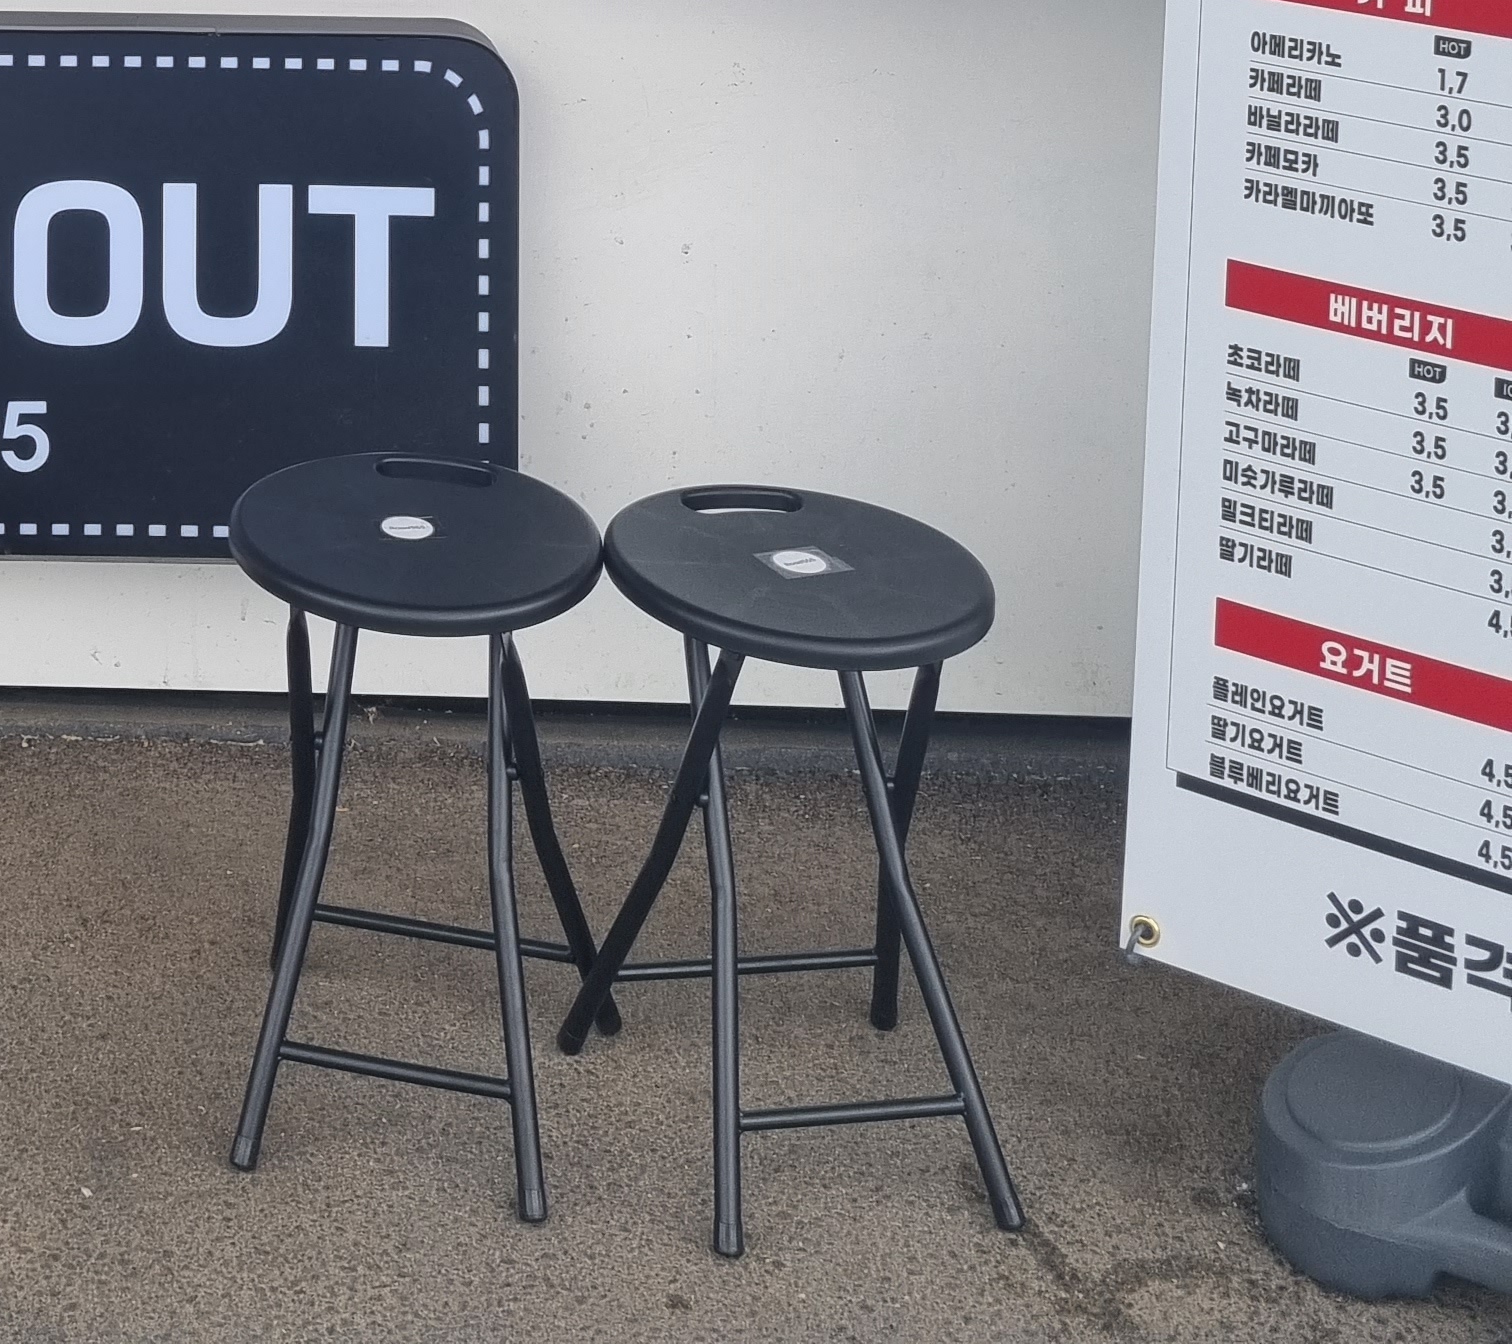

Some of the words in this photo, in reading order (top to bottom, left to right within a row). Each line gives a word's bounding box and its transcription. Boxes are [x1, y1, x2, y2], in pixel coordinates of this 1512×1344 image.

[1250, 31, 1342, 68] 아메리카노
[1437, 68, 1468, 95] 1,7
[1439, 40, 1467, 55] HOT
[1249, 68, 1322, 102] 카페라떼
[1436, 104, 1472, 133] 3,0
[1247, 104, 1339, 143] 바닐라라떼
[1434, 141, 1470, 169] 3,5
[1245, 141, 1319, 177] 카페모카
[1432, 177, 1468, 206] 3,5
[1431, 214, 1467, 243] 3,5
[1329, 293, 1453, 350] 베버리지
[1226, 343, 1300, 383] 초코라떼
[1413, 391, 1448, 421] 3,5
[1414, 363, 1442, 379] HOT
[1225, 381, 1299, 422] 녹차라떼
[1412, 430, 1447, 460] 3,5
[1222, 458, 1334, 510] 미숫가루라떼
[1223, 420, 1317, 466] 고구마라떼
[1410, 470, 1445, 500] 3,5
[1221, 497, 1313, 544] 밀크티라떼
[1219, 535, 1293, 578] 딸기라떼
[1320, 641, 1412, 694] 요거트
[1212, 675, 1324, 733] 플레인요거트
[1211, 714, 1303, 765] 딸기요거트
